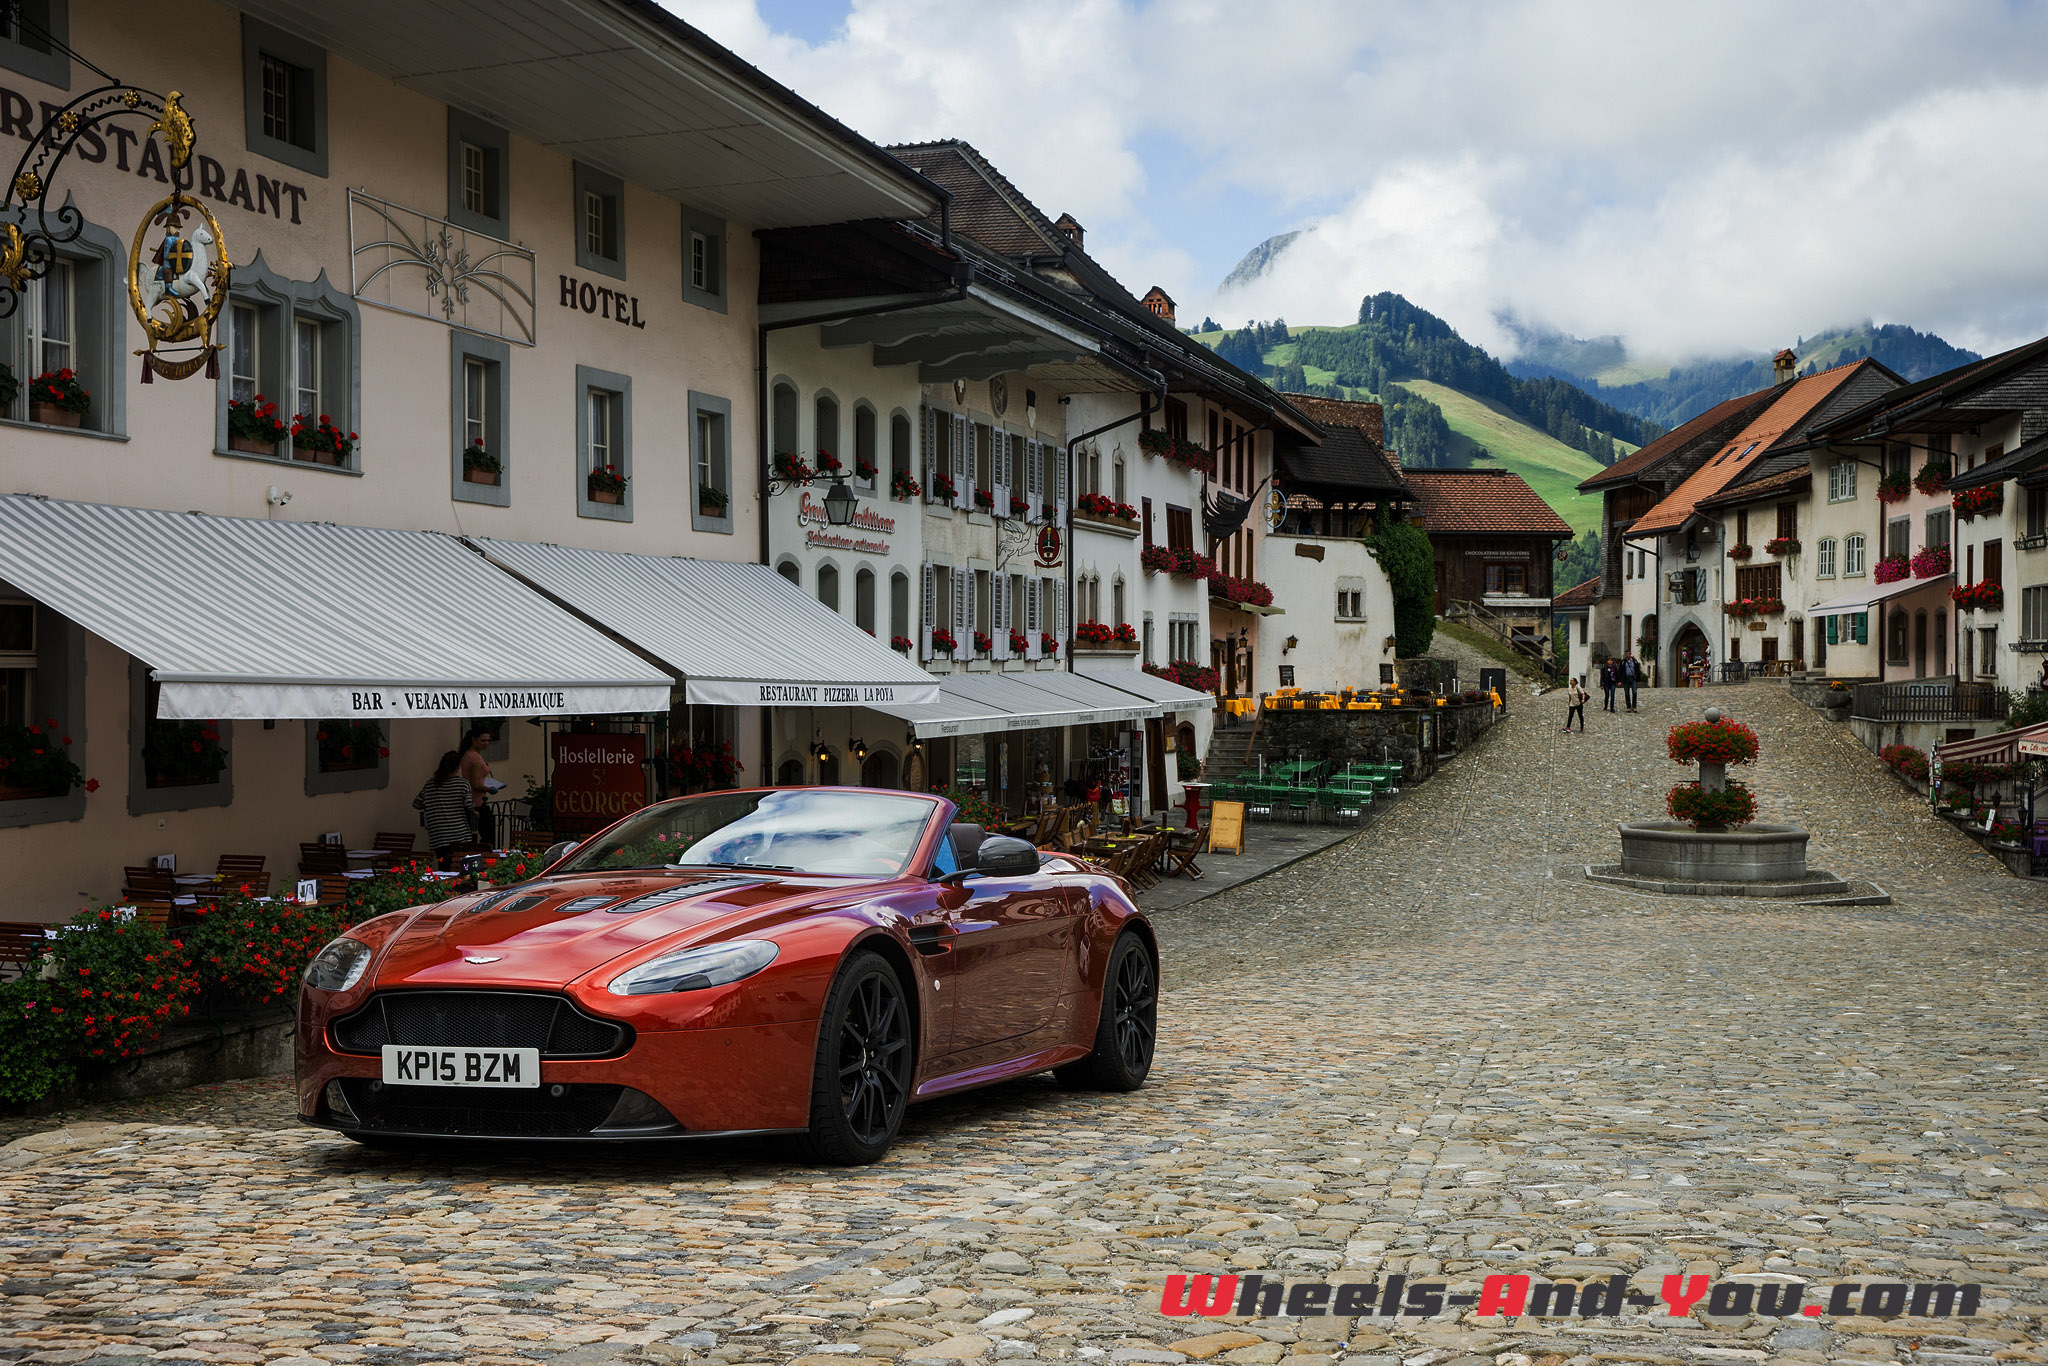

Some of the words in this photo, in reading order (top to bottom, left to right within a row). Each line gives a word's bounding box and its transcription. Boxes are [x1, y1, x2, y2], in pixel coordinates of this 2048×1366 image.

[559, 274, 646, 330] HOTEL
[352, 692, 384, 710] BAR
[404, 692, 469, 710] VERANDA
[479, 692, 565, 710] PANORAMIQUE
[760, 685, 818, 702] RESTAURANT
[824, 687, 859, 702] PIZZERIA
[864, 687, 874, 701] LA
[875, 687, 894, 701] POYA
[559, 746, 635, 764] Hostellerie
[555, 790, 644, 818] GEORGES
[397, 1051, 456, 1082] KP15
[464, 1053, 521, 1083] BZM
